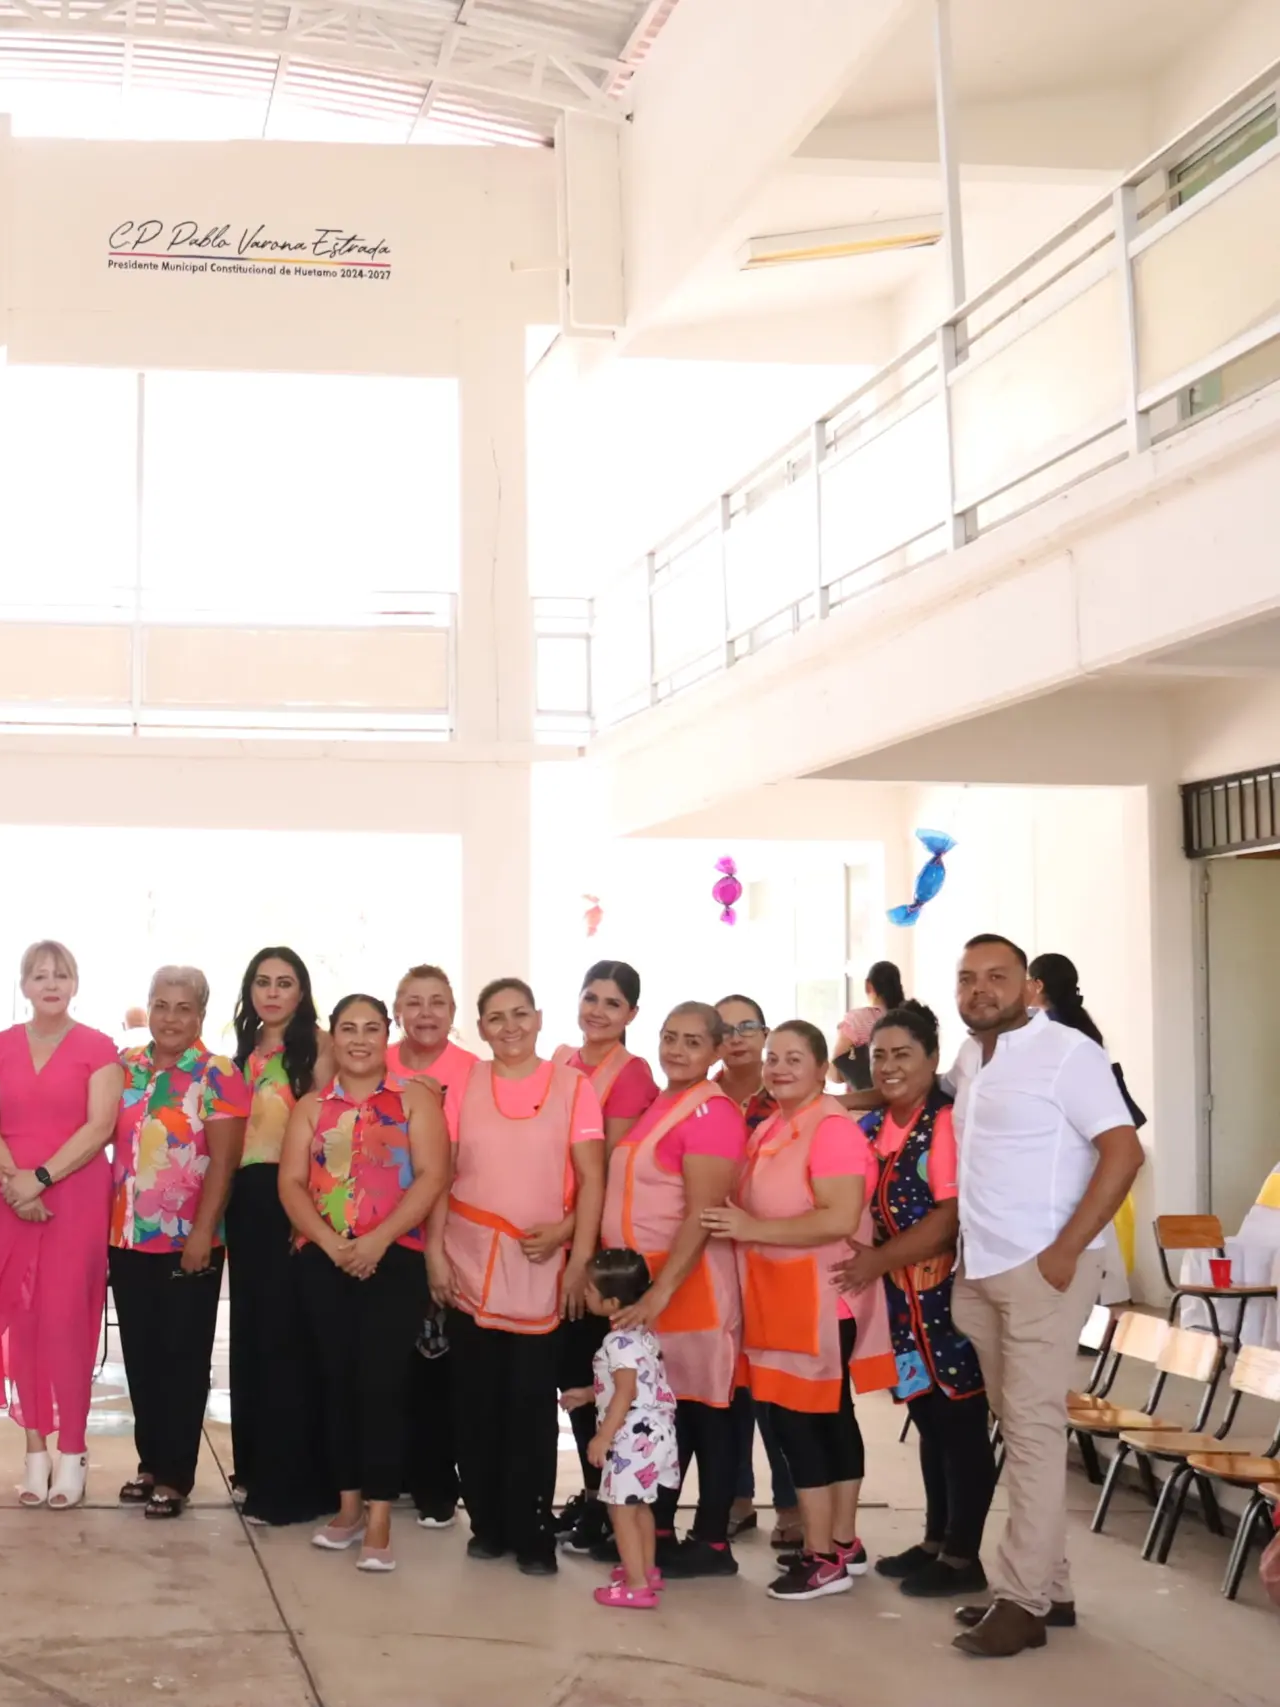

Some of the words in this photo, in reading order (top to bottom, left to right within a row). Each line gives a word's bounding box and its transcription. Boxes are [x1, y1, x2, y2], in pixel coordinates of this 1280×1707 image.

[108, 219, 163, 250] CP
[167, 220, 231, 251] Pablo
[238, 224, 308, 255] Varona
[312, 228, 391, 261] Estrada
[107, 259, 159, 271] Presidente
[161, 261, 208, 274] Municipal
[210, 262, 276, 275] Constitucional
[279, 265, 292, 275] de
[294, 266, 338, 278] Huetamo
[340, 268, 391, 280] 2024-2027
